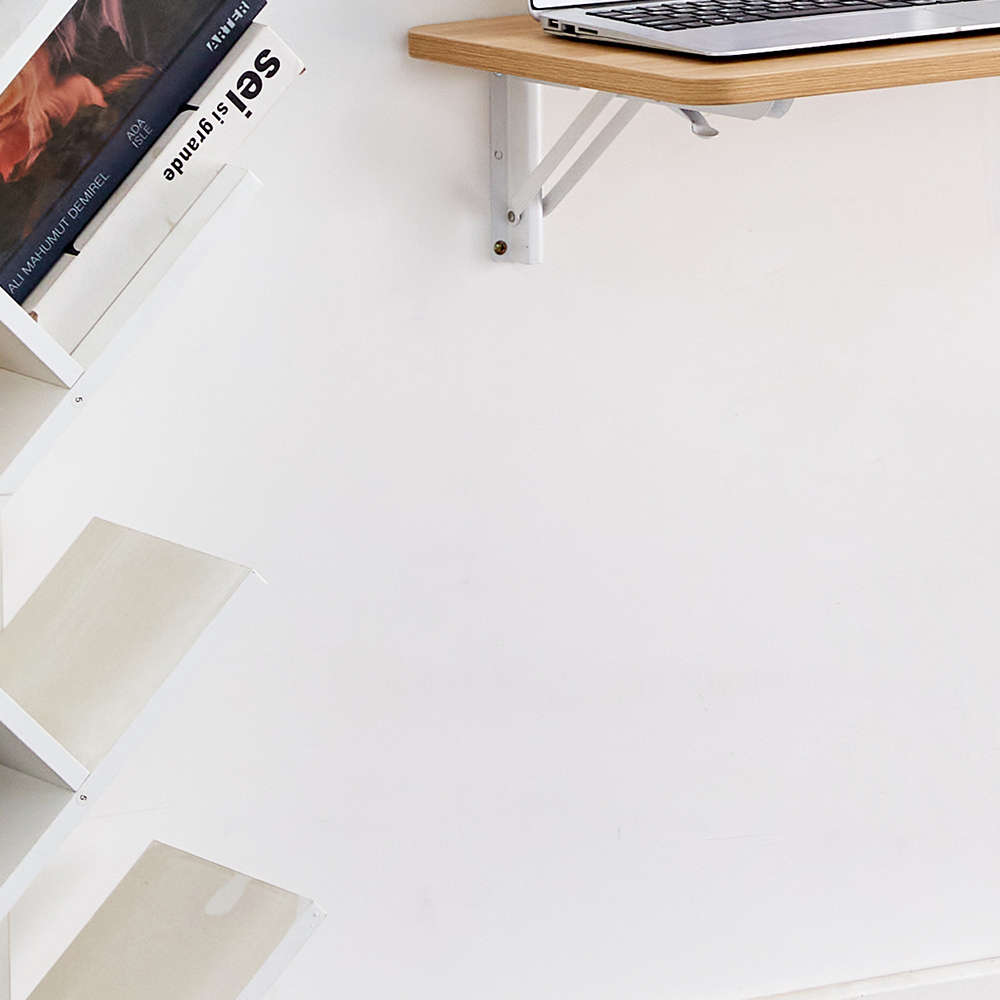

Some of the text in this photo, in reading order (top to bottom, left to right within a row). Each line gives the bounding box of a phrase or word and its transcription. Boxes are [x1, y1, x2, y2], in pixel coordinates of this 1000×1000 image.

[126, 118, 146, 141] ADA
[131, 126, 153, 149] ISLE
[163, 49, 281, 181] sei si grande
[8, 172, 110, 294] ALI MAHUMUT DEMIREL
